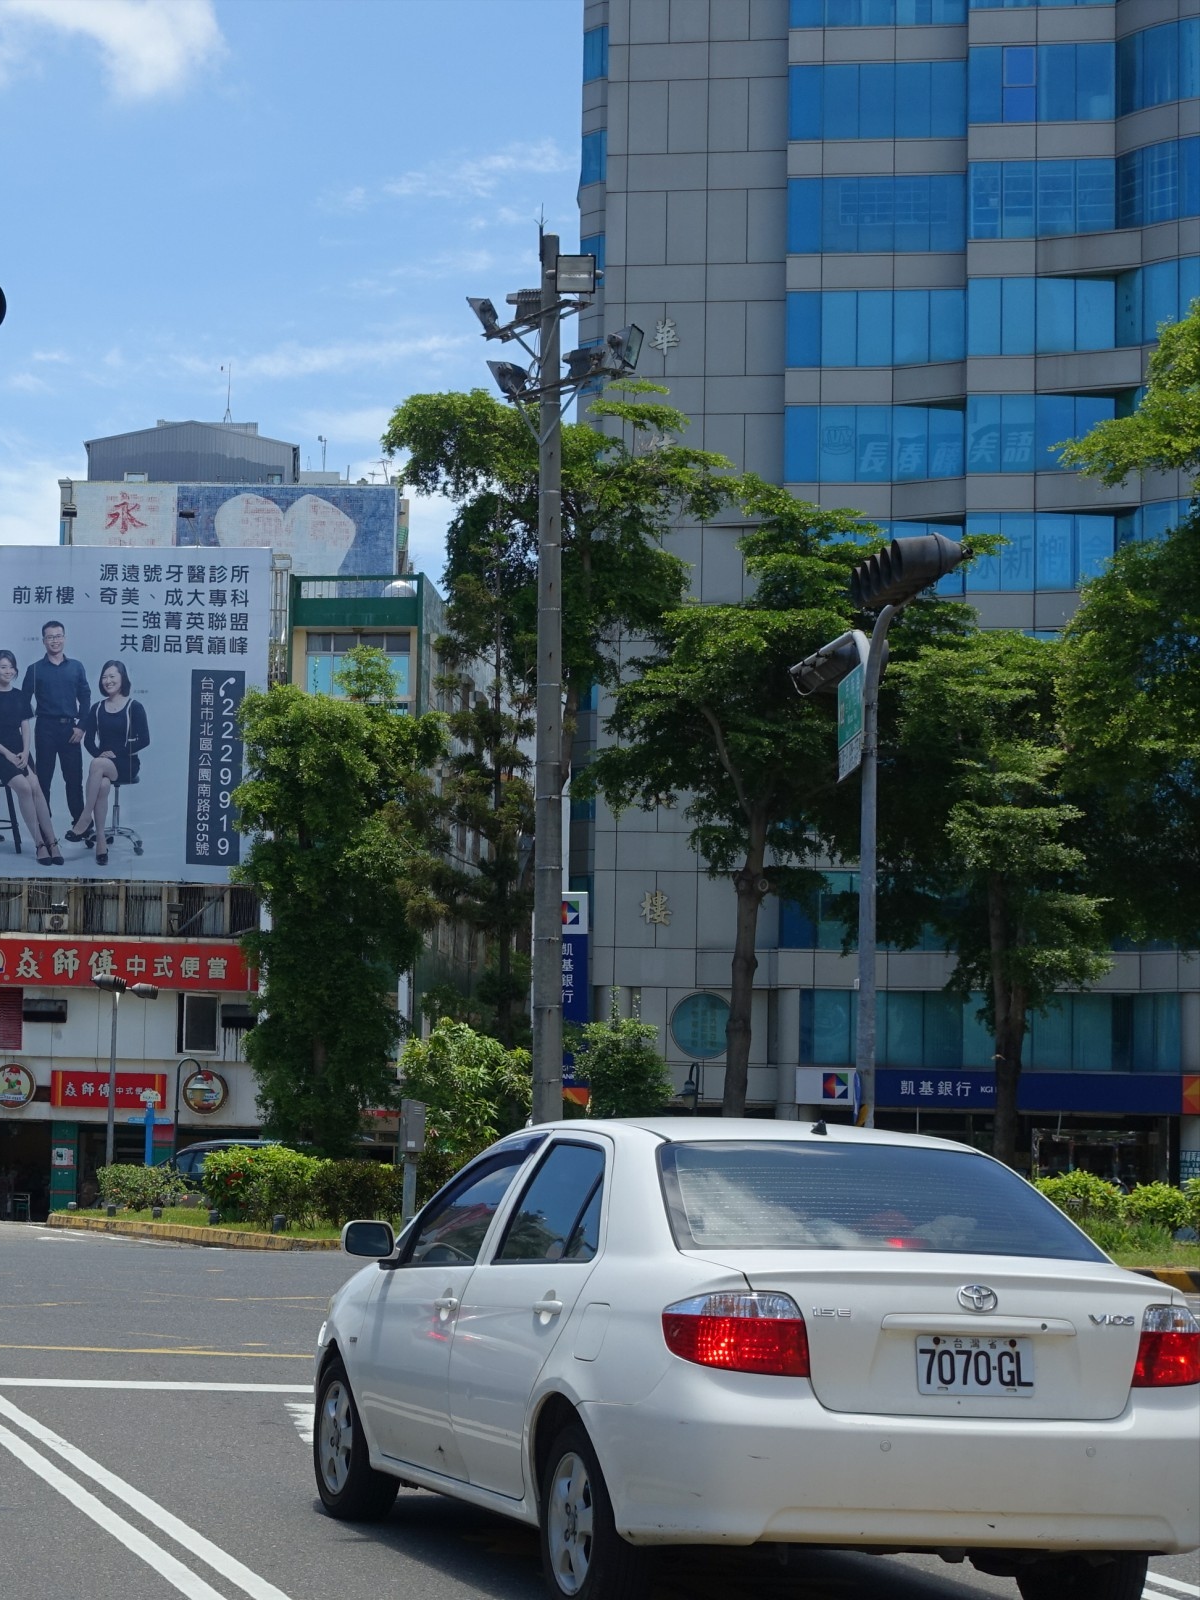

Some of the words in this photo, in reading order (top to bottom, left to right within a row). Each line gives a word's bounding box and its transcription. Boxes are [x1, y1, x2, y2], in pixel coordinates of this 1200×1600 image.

[100, 564, 250, 584] 源遠號牙醫診所
[120, 610, 249, 632] 三強菁英聯盟
[120, 634, 249, 655] 共創品質巔峰
[195, 676, 215, 856] 台南市北區公園南路355號
[217, 698, 235, 856] 2229919
[126, 954, 228, 980] 中式便當
[900, 1080, 972, 1097] 凱基銀行
[952, 1337, 998, 1350] 台灣省
